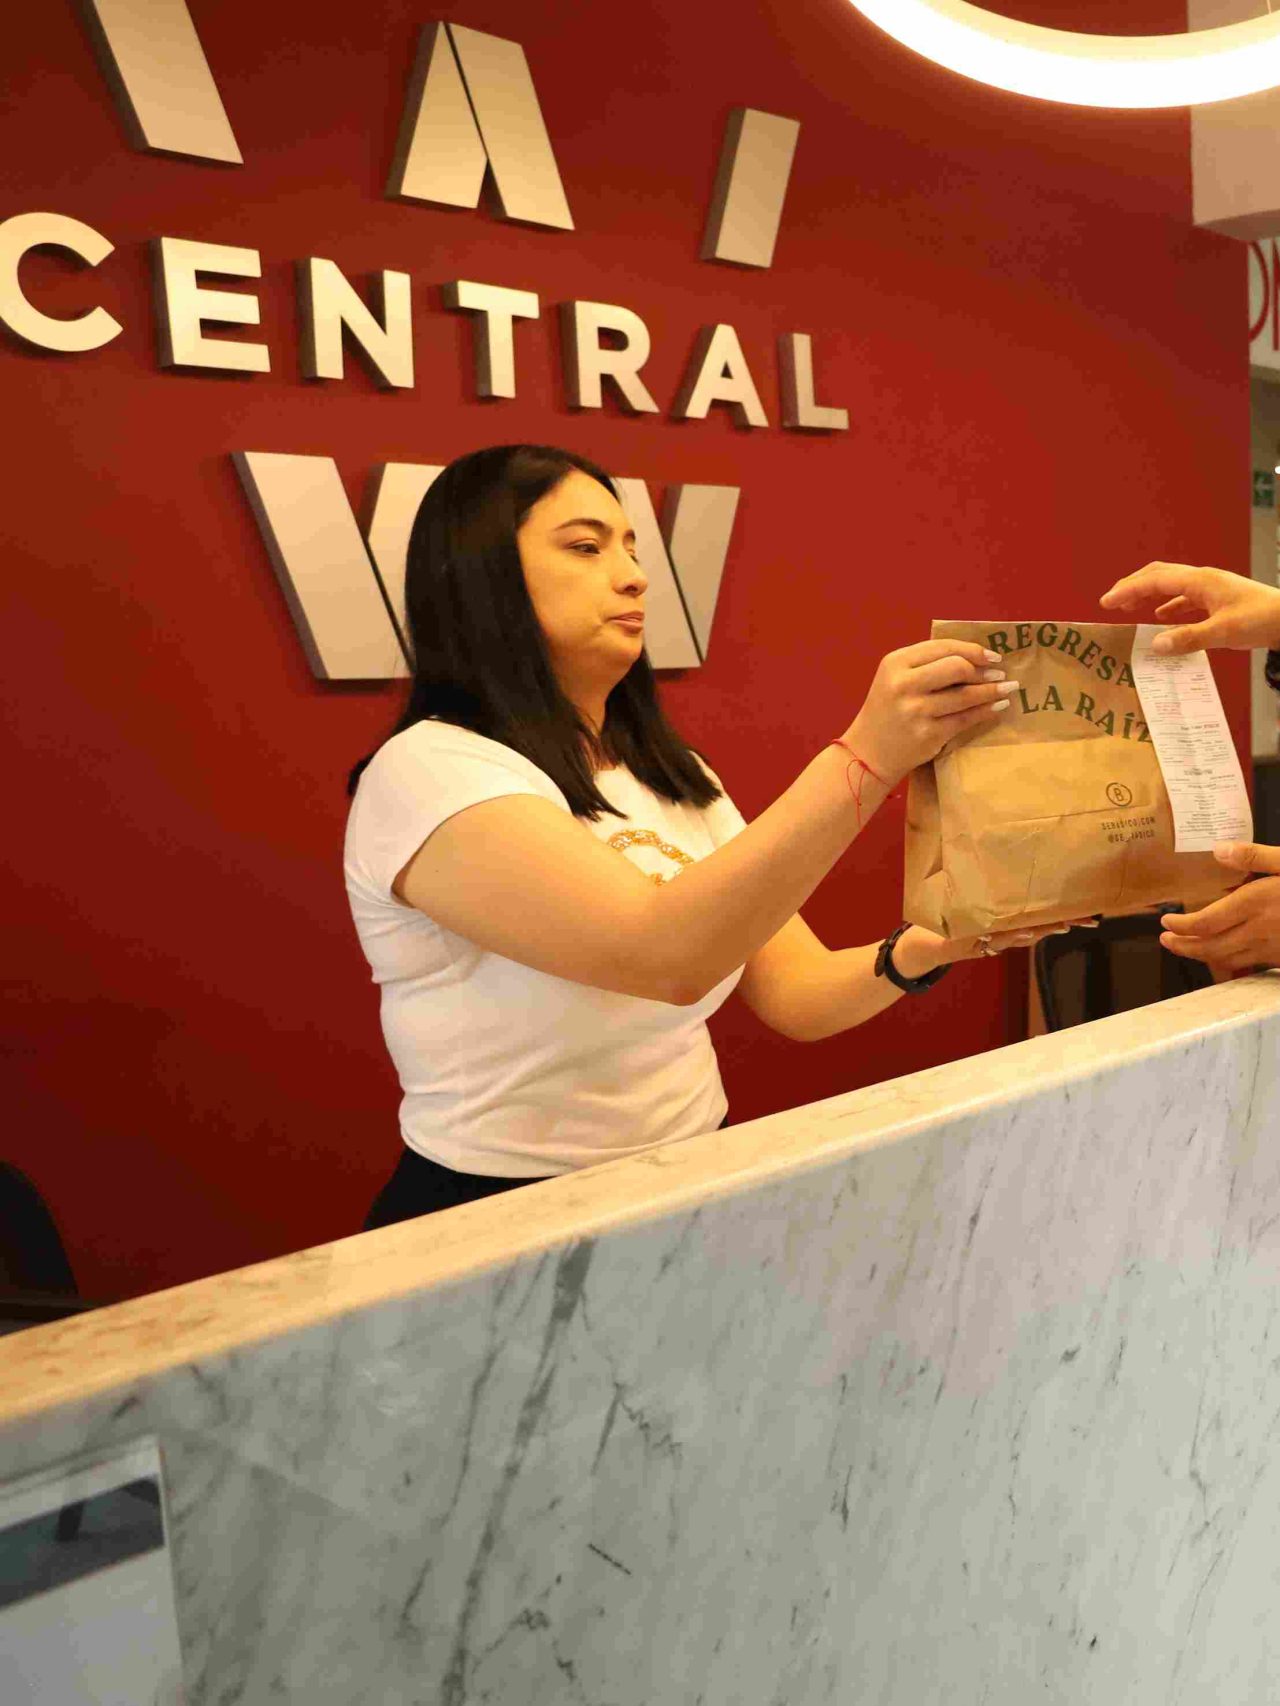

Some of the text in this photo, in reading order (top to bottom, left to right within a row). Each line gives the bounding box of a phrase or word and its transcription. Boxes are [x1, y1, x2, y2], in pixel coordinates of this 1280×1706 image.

[0, 211, 850, 431] CENTRAL
[987, 622, 1137, 689] REGRESA
[1018, 685, 1064, 715] LA
[1075, 691, 1153, 744] RAÍZ
